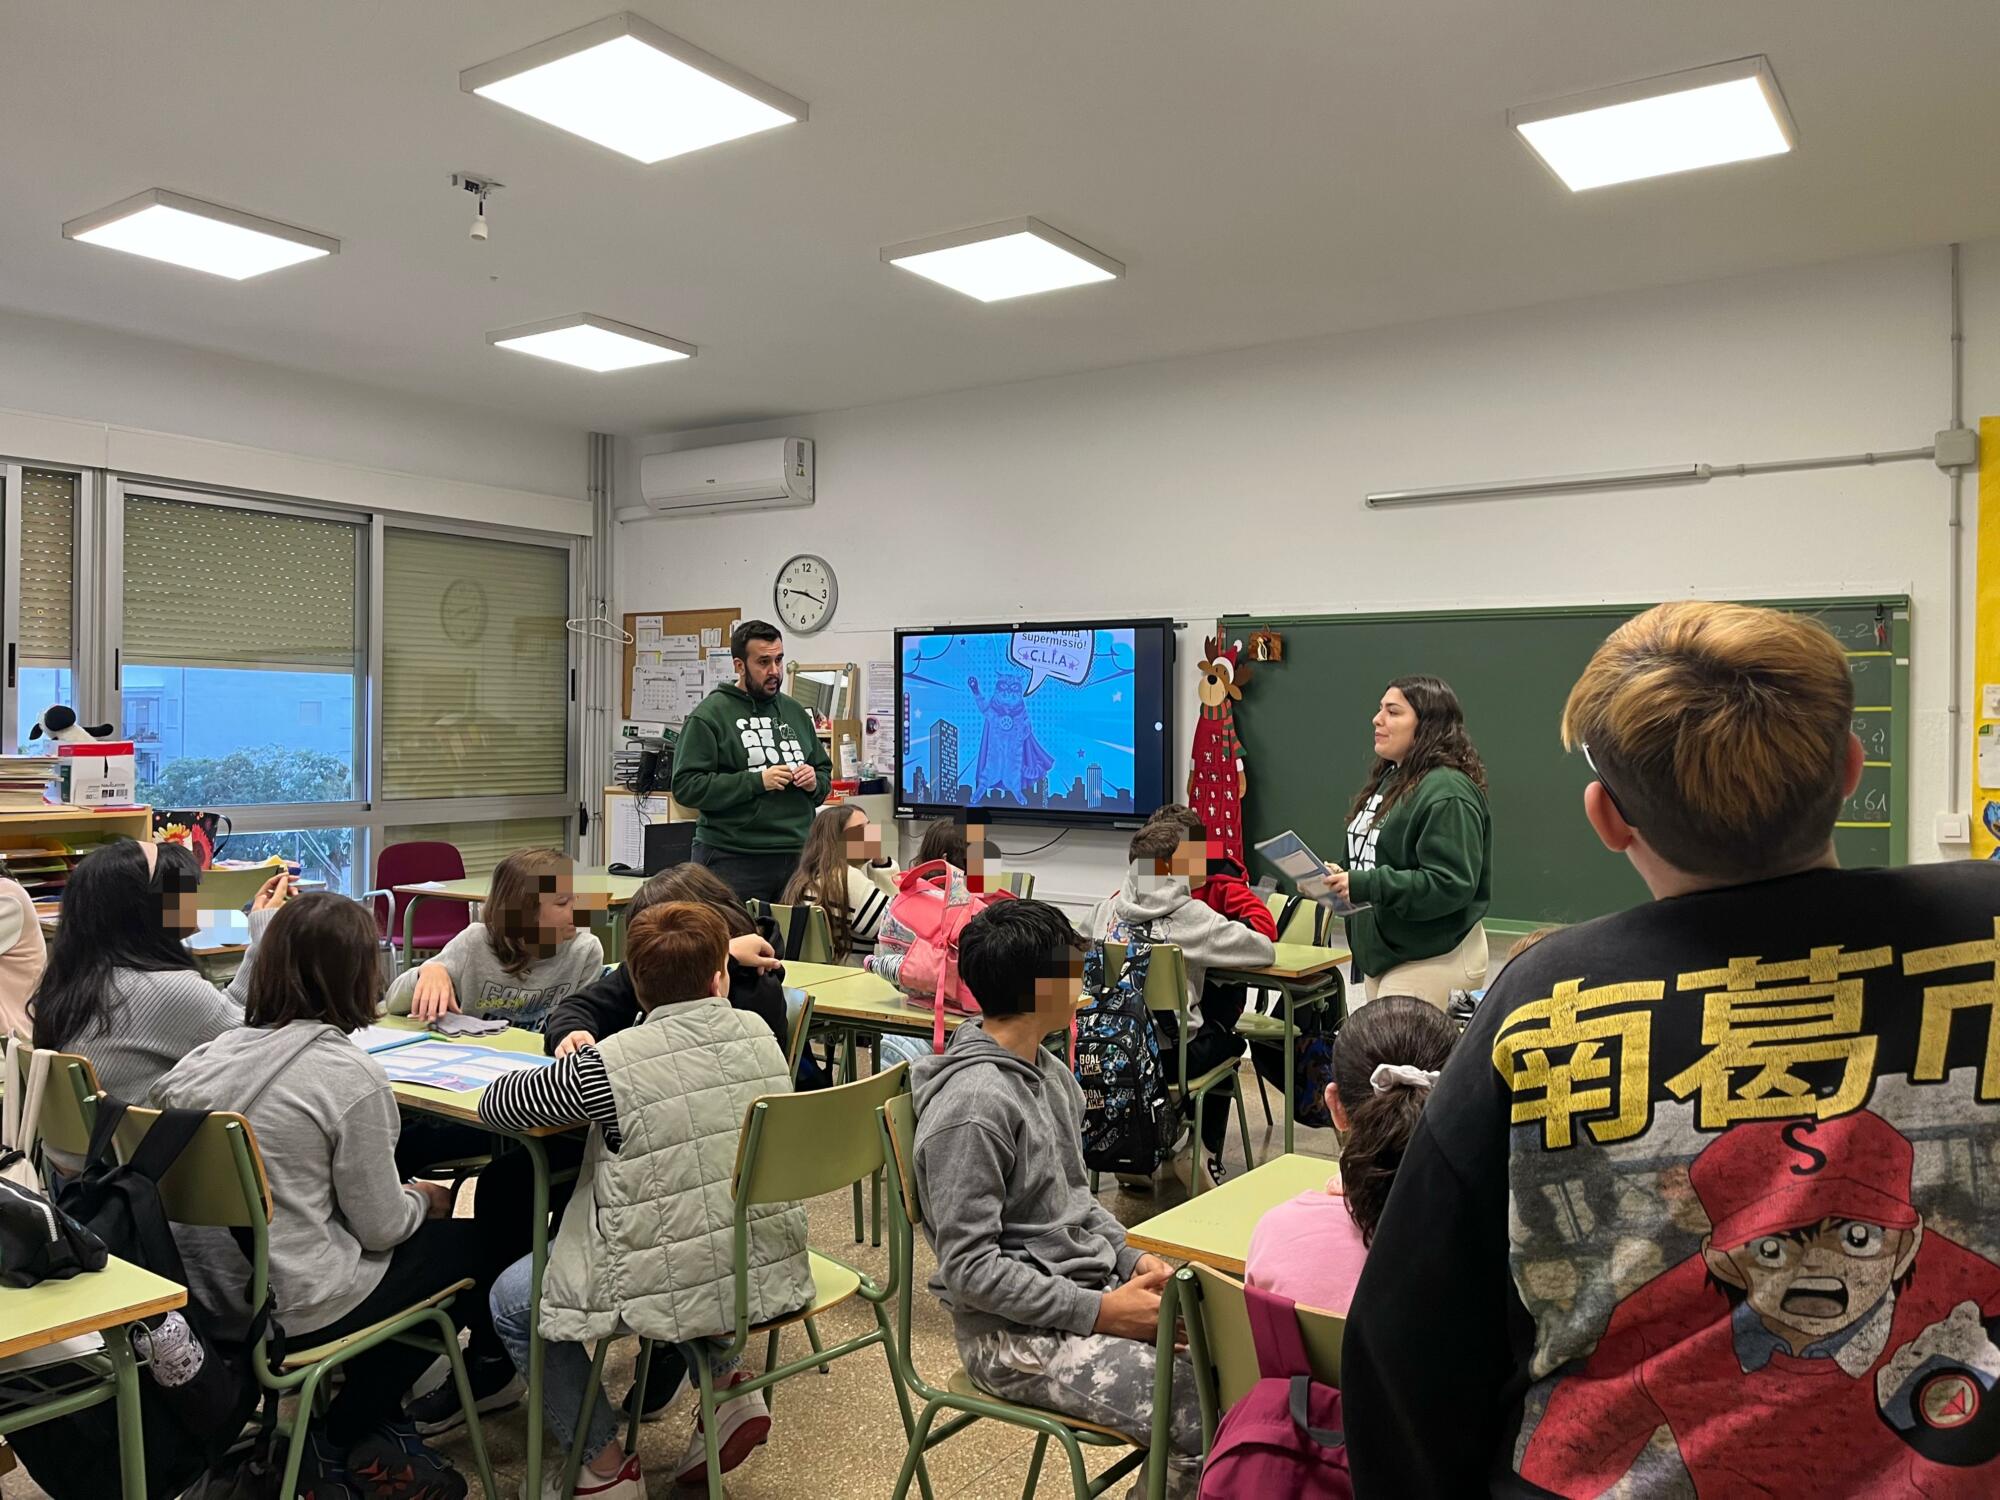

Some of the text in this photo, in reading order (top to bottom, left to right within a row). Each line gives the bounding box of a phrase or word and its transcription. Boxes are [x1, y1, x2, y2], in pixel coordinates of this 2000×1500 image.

[802, 563, 811, 572] 12
[783, 588, 788, 598] 9
[822, 589, 827, 599] 3
[801, 615, 806, 624] 6
[1022, 632, 1087, 649] supermissió!
[480, 980, 571, 1009] GAMER
[1080, 1054, 1101, 1065] GOAL
[1780, 1122, 1827, 1175] S
